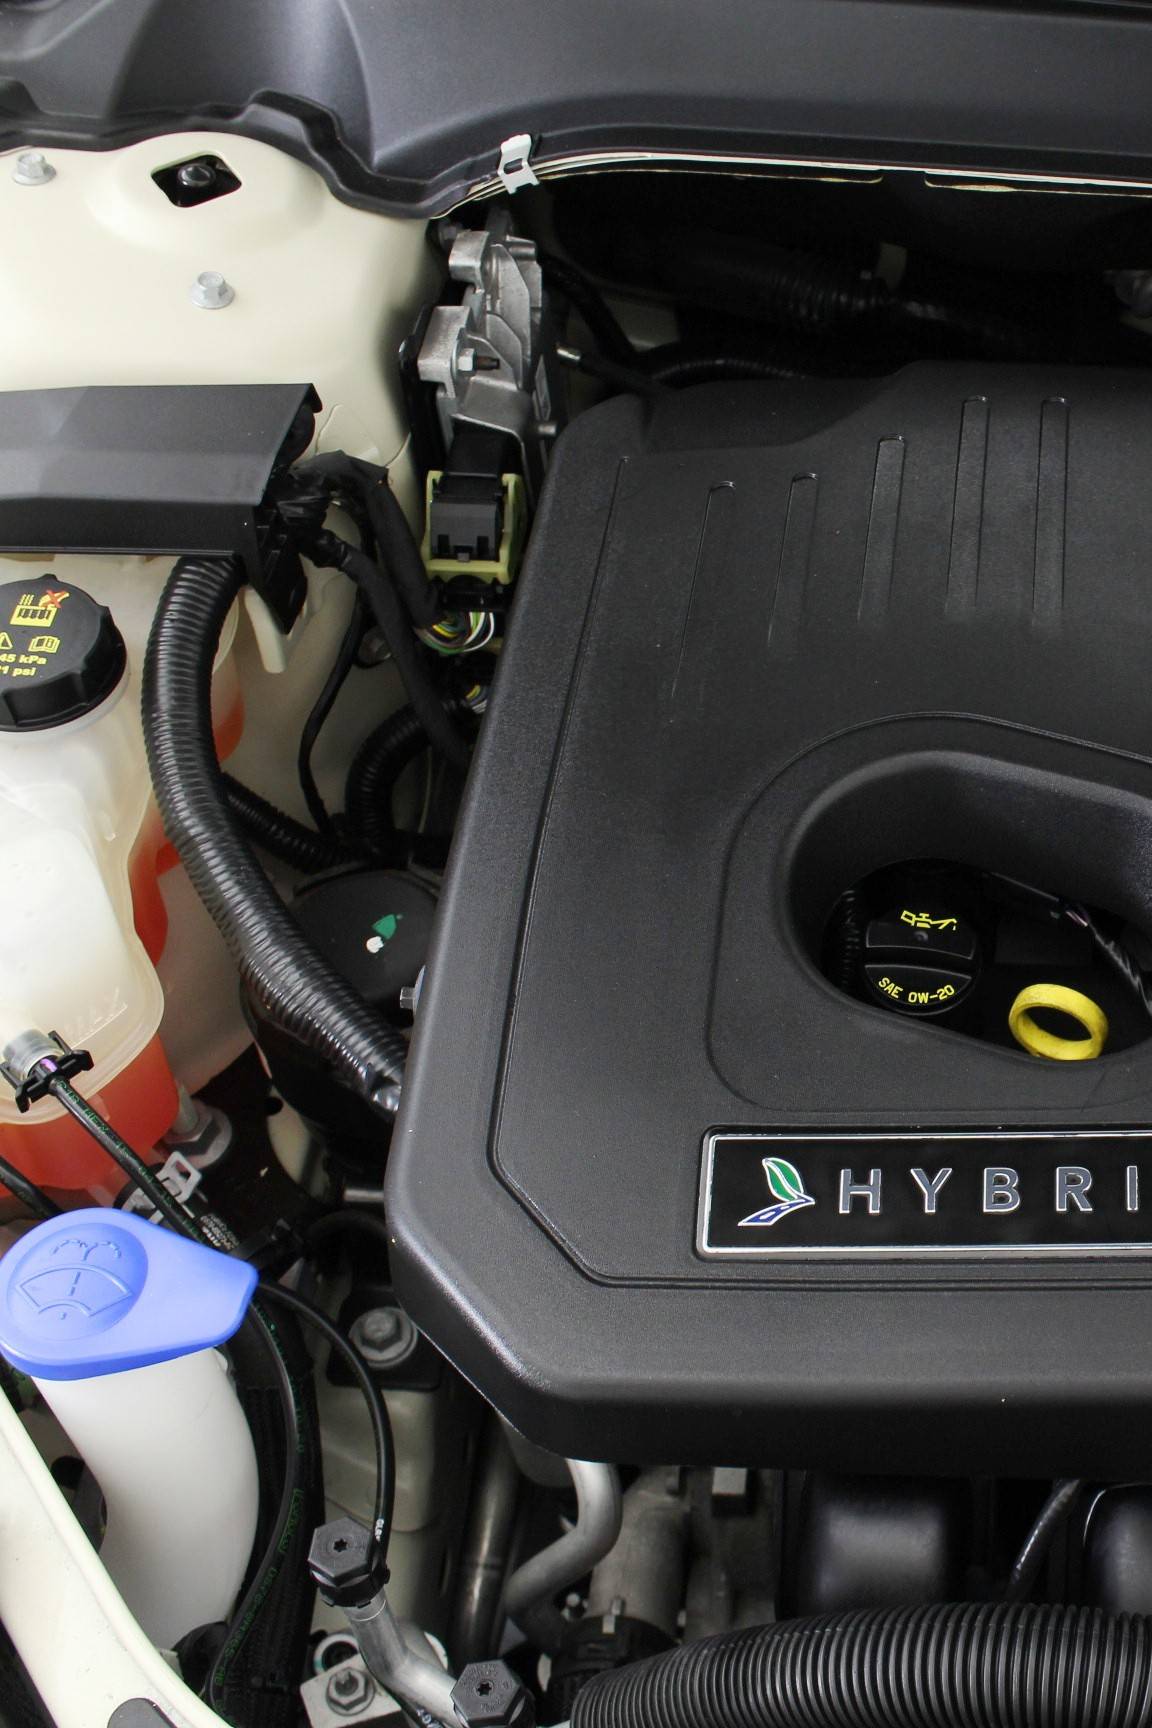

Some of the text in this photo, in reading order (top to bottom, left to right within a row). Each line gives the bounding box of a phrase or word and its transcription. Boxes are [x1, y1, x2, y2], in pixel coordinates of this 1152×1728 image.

[19, 654, 47, 664] kPa
[12, 666, 36, 677] psi
[877, 976, 903, 1000] SAE
